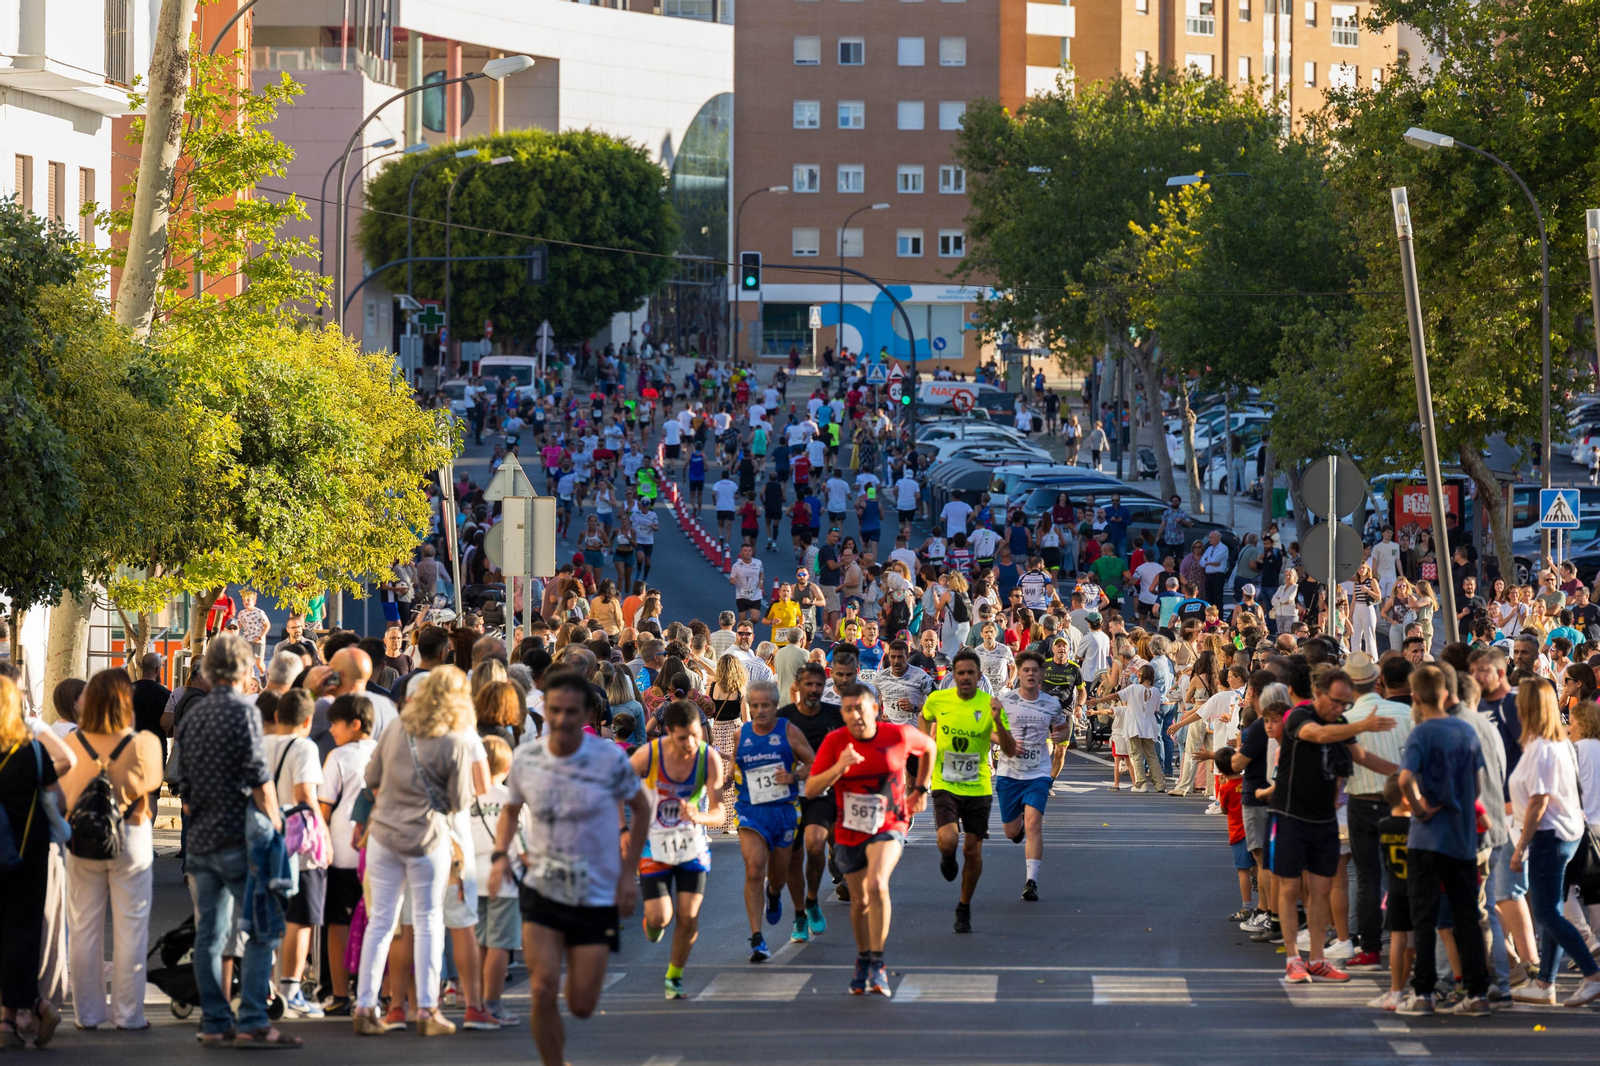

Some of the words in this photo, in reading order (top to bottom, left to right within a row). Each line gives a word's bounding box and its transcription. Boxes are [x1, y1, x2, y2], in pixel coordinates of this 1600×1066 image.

[954, 558, 970, 571] 12
[950, 728, 981, 738] COASA
[951, 760, 973, 772] 178
[851, 804, 877, 818] 567
[661, 838, 688, 853] 114
[1389, 845, 1408, 880] 5
